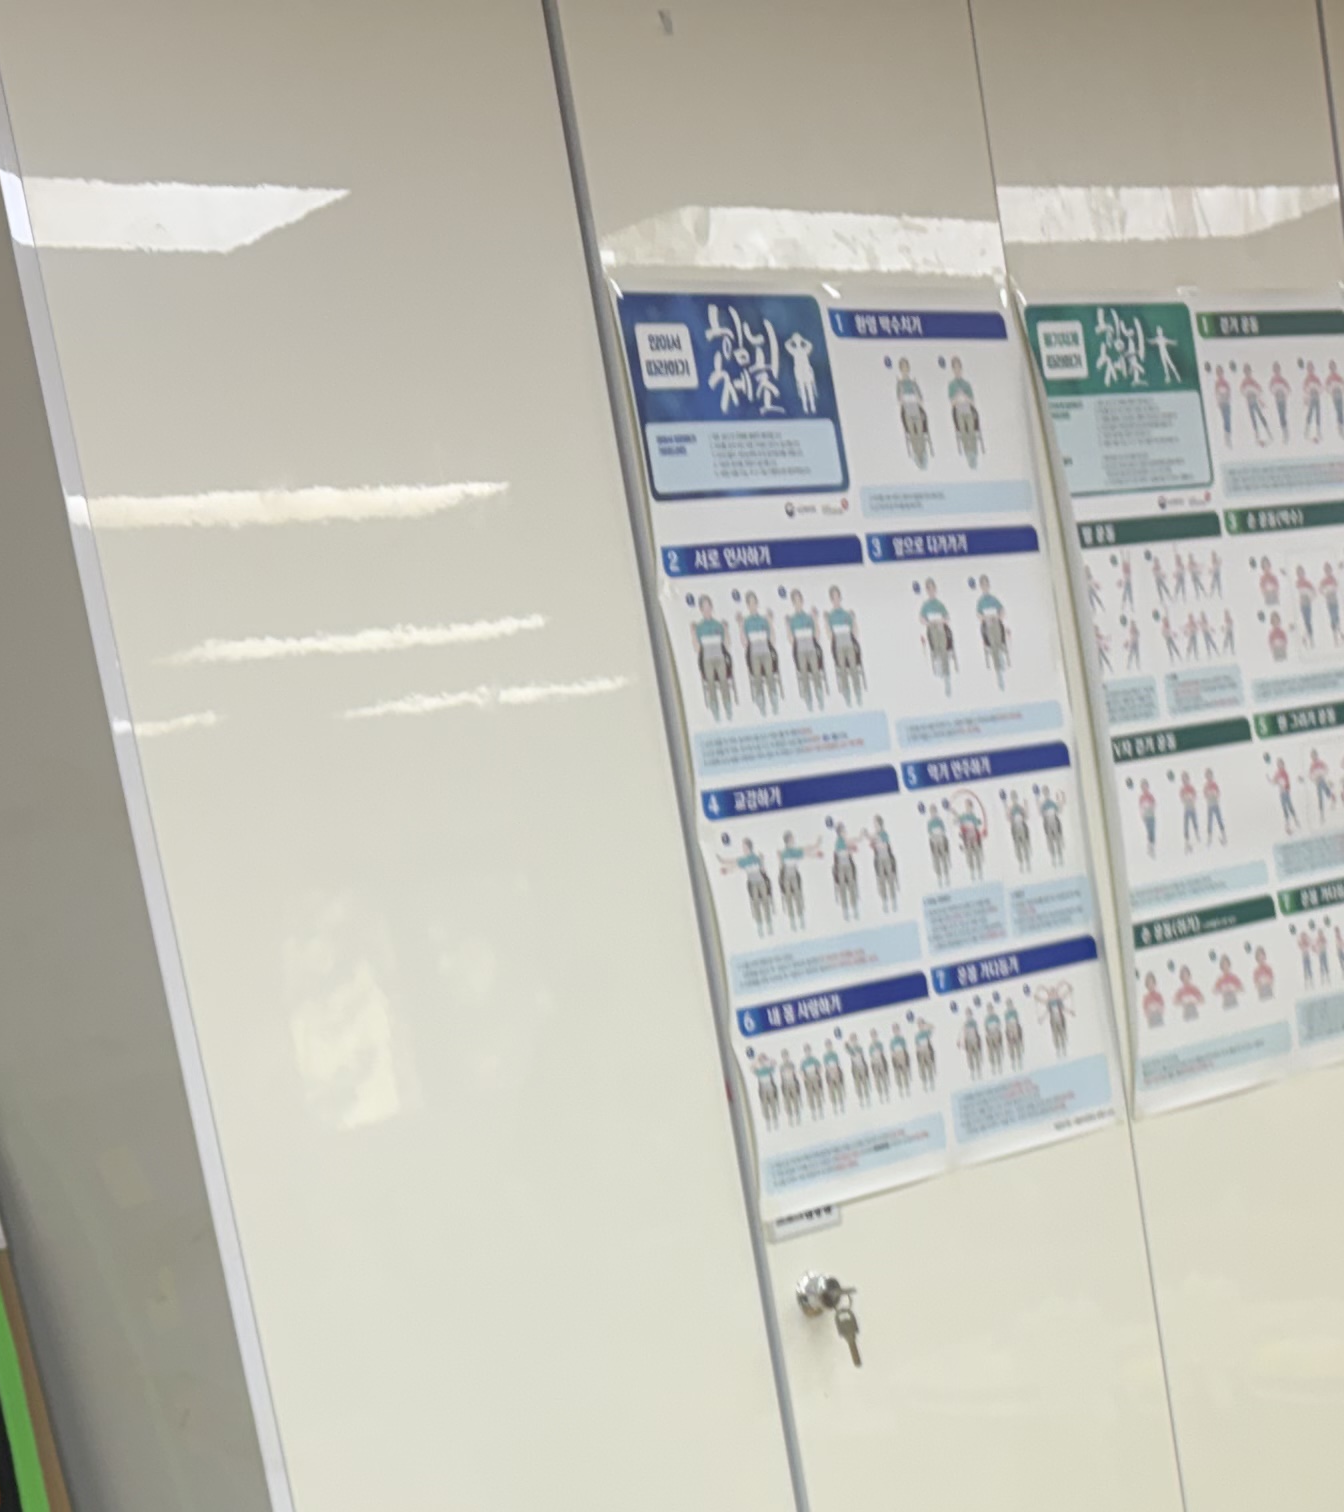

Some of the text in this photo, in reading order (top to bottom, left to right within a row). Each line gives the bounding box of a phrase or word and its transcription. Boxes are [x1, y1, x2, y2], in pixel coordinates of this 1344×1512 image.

[834, 313, 844, 334] 1
[879, 314, 924, 336] 박수치기
[648, 334, 682, 351] 앉아서
[646, 358, 690, 377] 따라하기
[871, 536, 883, 558] 3
[926, 533, 969, 555] 다가가기
[667, 544, 772, 572] 2 서로 인사하기
[906, 756, 993, 786] 5 악기 연주하기
[707, 794, 720, 816] 4
[935, 970, 946, 990] 7
[743, 1011, 756, 1033] 6
[767, 1007, 780, 1027] 내
[797, 994, 843, 1021] 사랑하기
